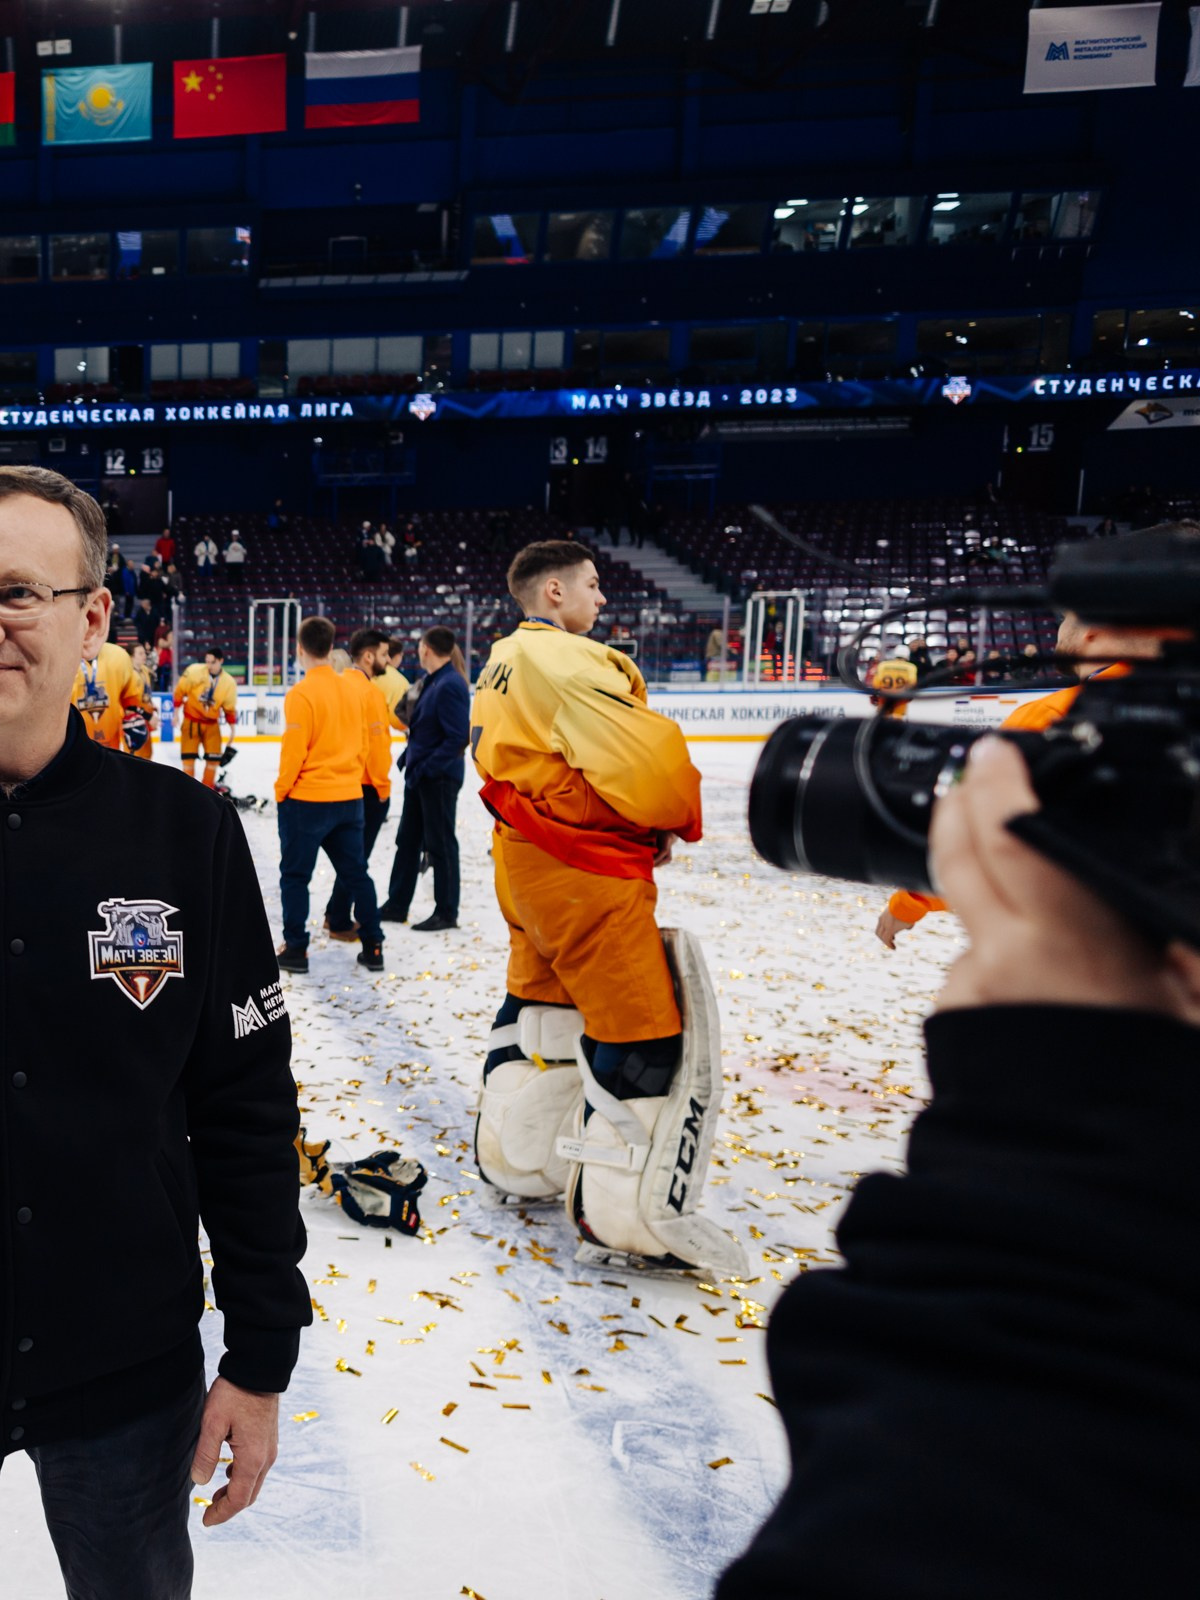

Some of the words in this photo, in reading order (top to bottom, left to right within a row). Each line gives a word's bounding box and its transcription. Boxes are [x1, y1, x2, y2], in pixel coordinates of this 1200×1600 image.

[1034, 374, 1200, 395] СТУДЕНЧЕСК
[572, 394, 628, 410] МАТЧ
[640, 389, 710, 408] ЗВЁЗД
[740, 388, 797, 405] 2023
[165, 403, 290, 421] ХОККЕЙНАЯ
[300, 402, 354, 417] ЛИГА
[1028, 423, 1054, 446] 15
[105, 449, 125, 470] 12
[142, 448, 163, 469] 13
[654, 706, 724, 720] ЕНЧЕСКАЯ
[264, 993, 284, 1010] МЕТА
[267, 1005, 287, 1022] КОМ
[666, 1097, 706, 1213] CCM
